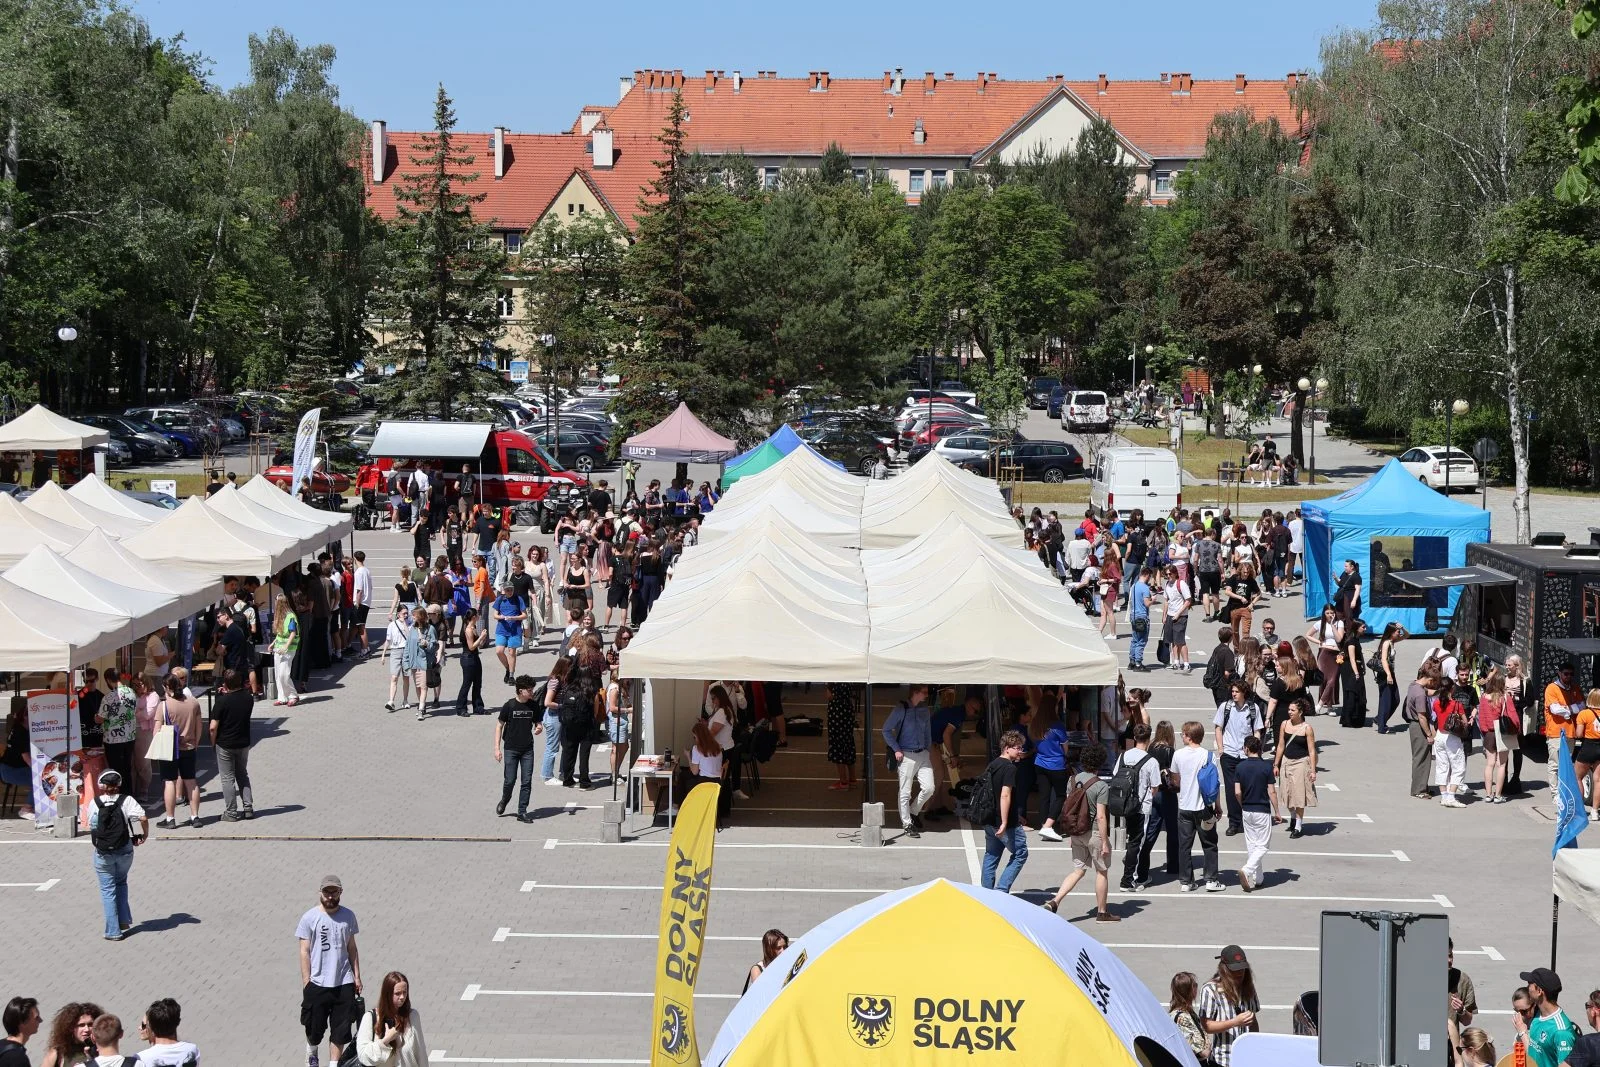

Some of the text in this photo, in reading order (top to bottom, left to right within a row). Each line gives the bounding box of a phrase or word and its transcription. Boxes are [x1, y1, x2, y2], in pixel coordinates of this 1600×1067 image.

[666, 846, 692, 983] DOLNY
[914, 998, 1025, 1023] DOLNY
[913, 1018, 1017, 1055] ŚLĄSK
